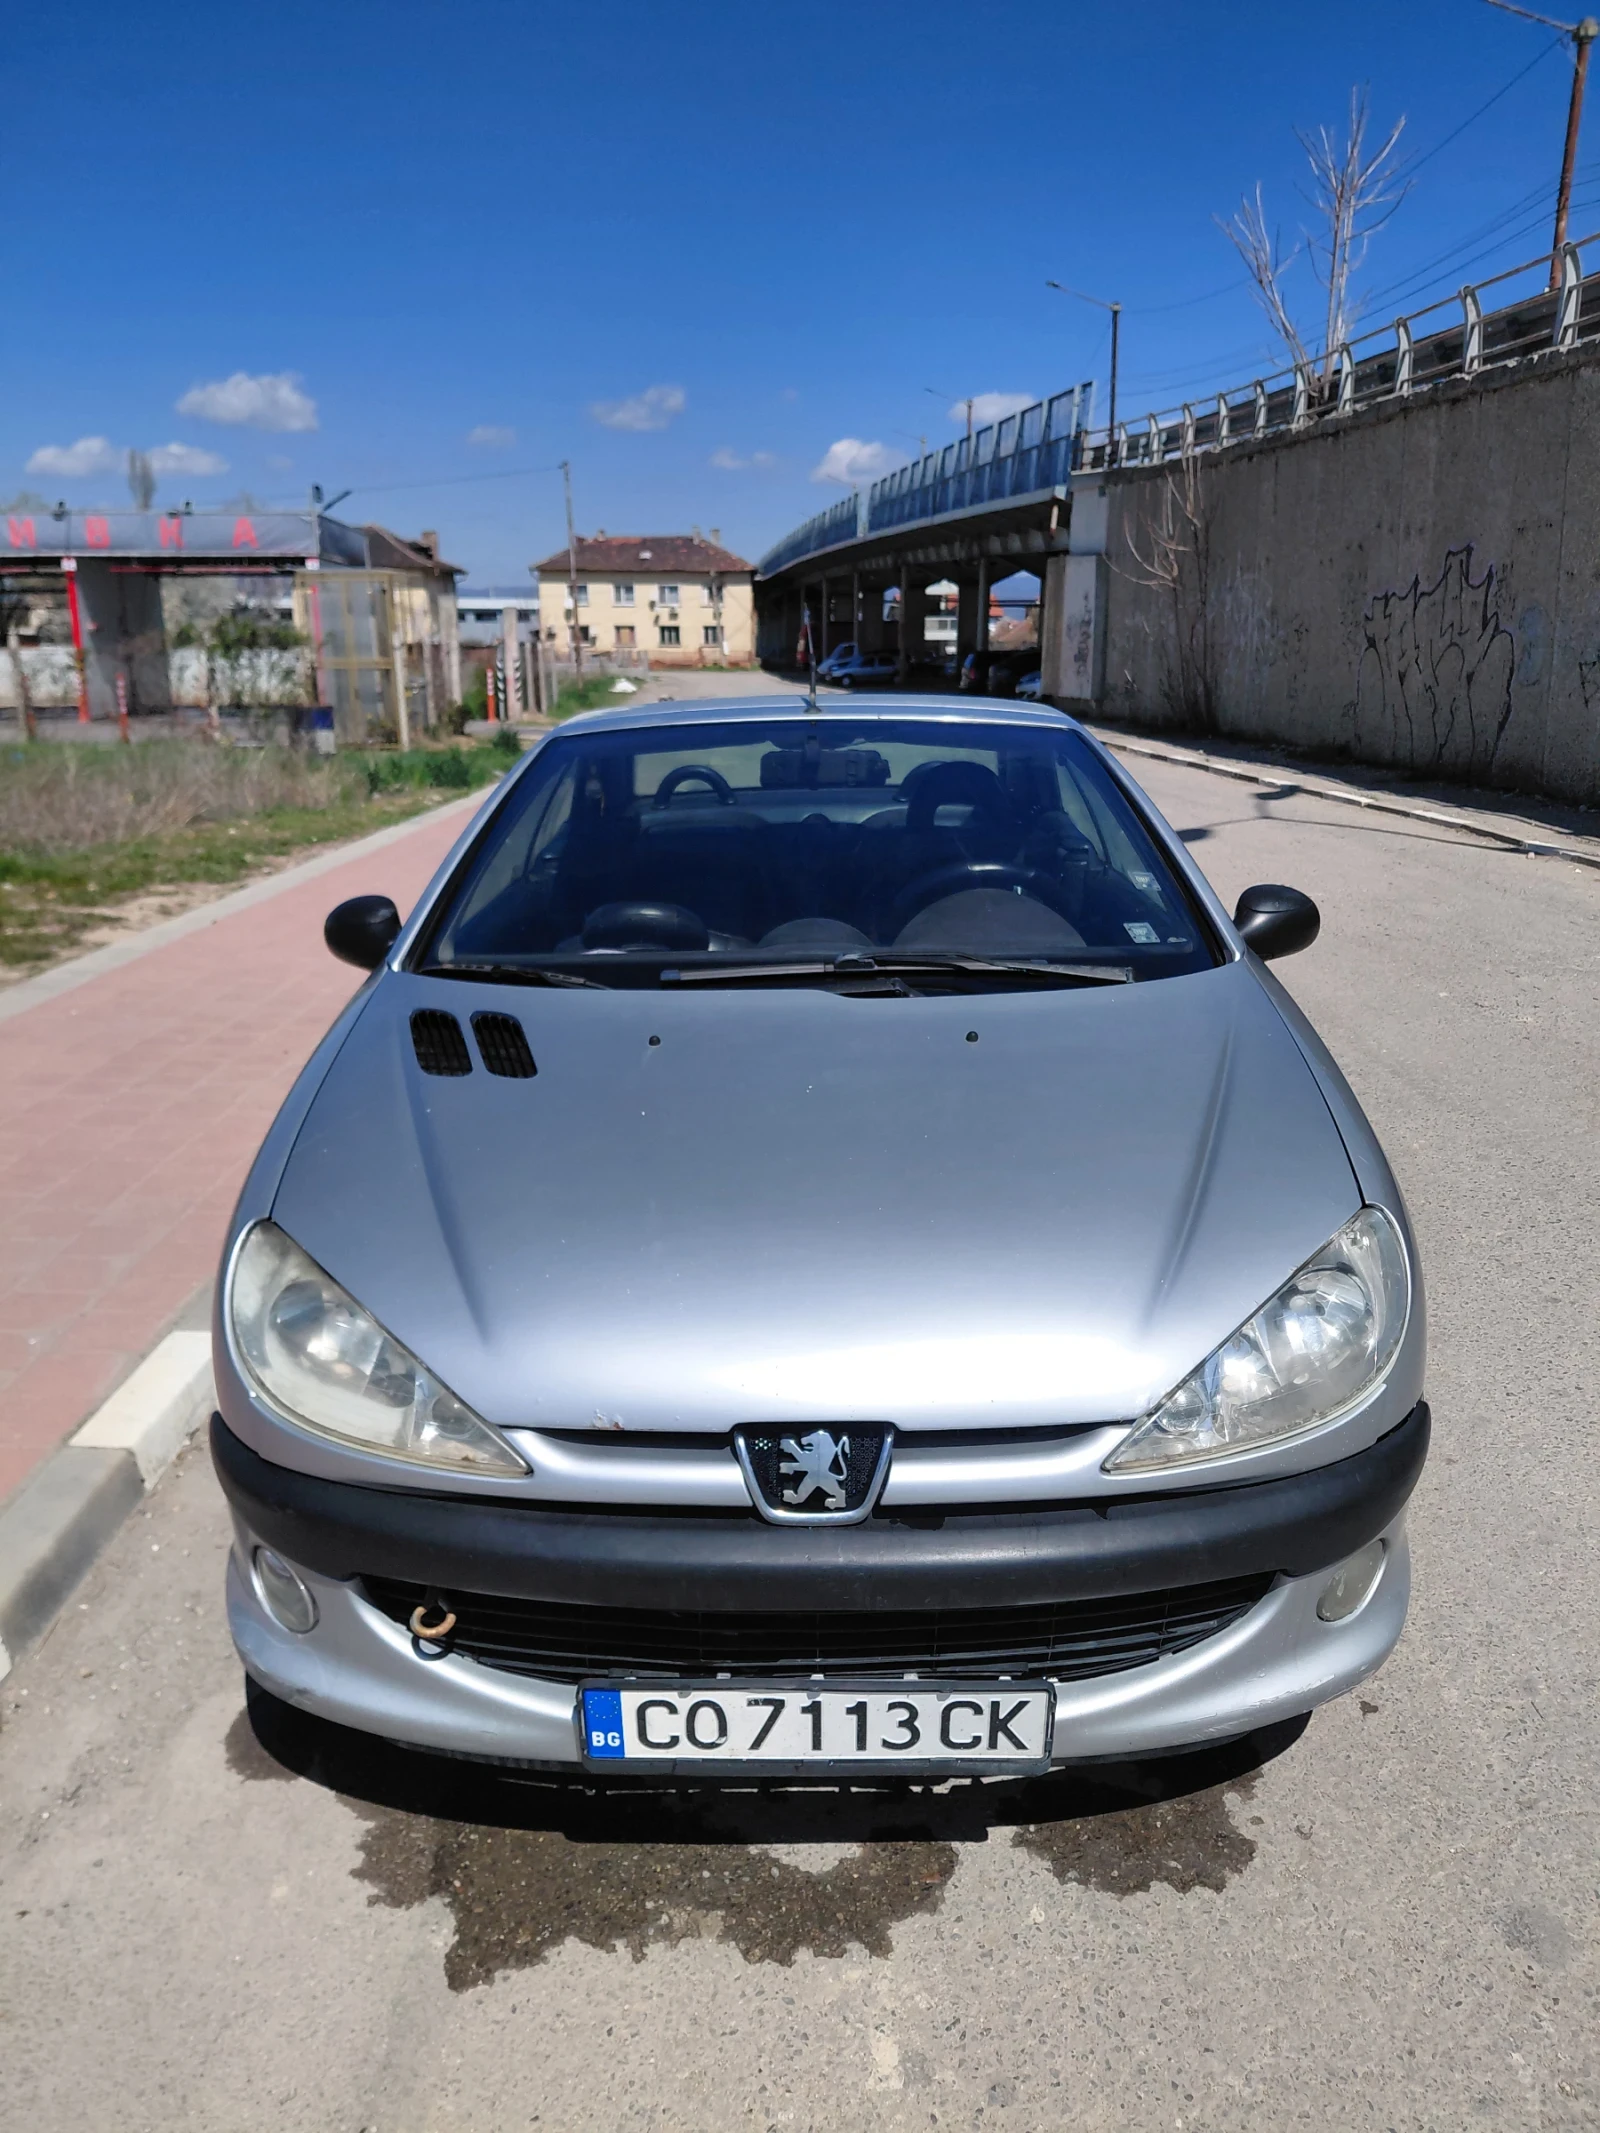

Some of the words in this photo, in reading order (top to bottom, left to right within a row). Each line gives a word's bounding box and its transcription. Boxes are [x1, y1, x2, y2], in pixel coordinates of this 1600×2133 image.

[591, 1731, 621, 1747] BG
[636, 1699, 728, 1750] CO
[746, 1698, 921, 1751] 7113
[940, 1699, 1030, 1750] CK
